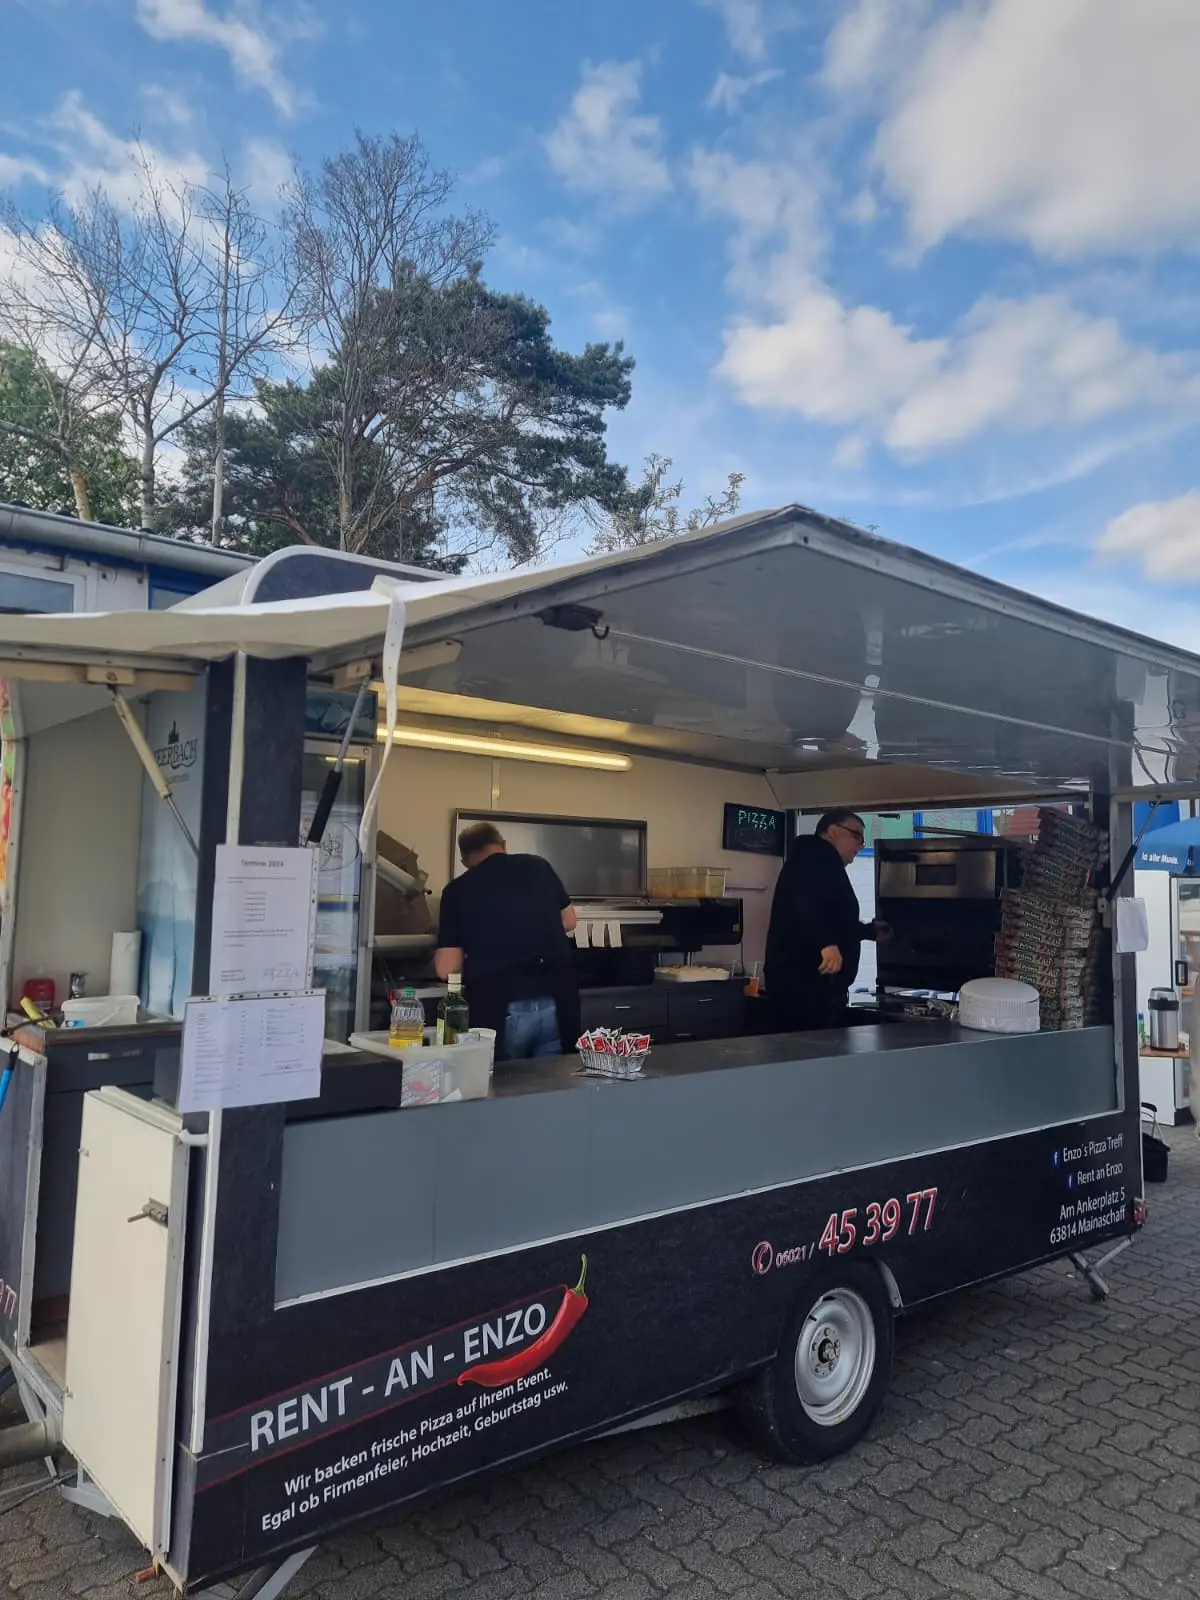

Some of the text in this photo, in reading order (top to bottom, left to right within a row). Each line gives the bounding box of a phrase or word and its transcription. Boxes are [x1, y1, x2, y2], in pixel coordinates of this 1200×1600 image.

[738, 809, 776, 830] PIZZA
[1089, 1141, 1107, 1156] Pizza
[1107, 1133, 1123, 1150] Treff
[1077, 1169, 1095, 1185] Rent
[1096, 1168, 1105, 1181] an
[1106, 1163, 1123, 1178] Enzo
[1060, 1187, 1126, 1220] Am Ankerplatz 5
[775, 1245, 806, 1268] 06021
[818, 1208, 858, 1257] 45
[863, 1198, 900, 1246] 39
[906, 1186, 938, 1236] 77
[1050, 1204, 1126, 1244] 63814 Mainaschaff
[251, 1376, 353, 1452] RENT
[384, 1345, 434, 1397] AN
[463, 1303, 546, 1364] ENZO
[284, 1367, 552, 1497] Wir backen frische Pizza auf Ihrem Event.
[262, 1381, 569, 1531] Egal ob Firmenfeier, Hochzeit, Geburtstag usw.
